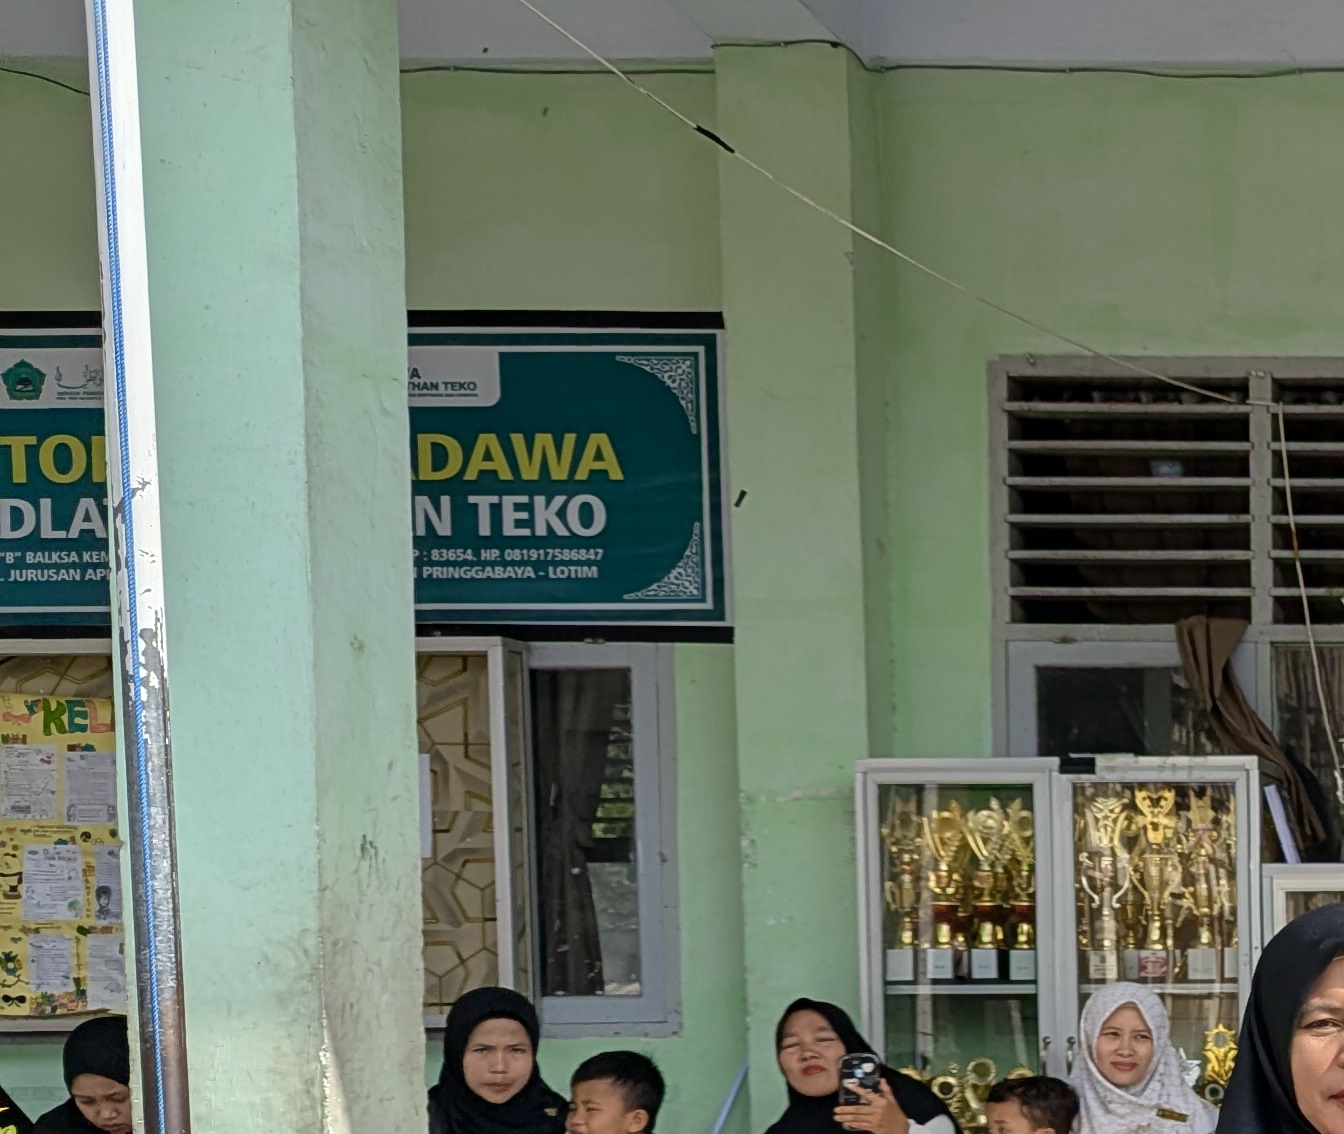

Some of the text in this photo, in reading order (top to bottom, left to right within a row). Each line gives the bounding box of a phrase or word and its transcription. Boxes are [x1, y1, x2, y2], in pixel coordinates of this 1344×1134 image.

[442, 381, 477, 391] TEKO
[468, 493, 607, 537] TEKO
[26, 551, 79, 563] BALKSA
[431, 548, 478, 561] 83654.
[481, 548, 501, 561] HP.
[504, 548, 604, 561] 081917586847
[9, 569, 81, 581] JURUSAN
[422, 566, 536, 579] PRINGGABAYA
[548, 566, 598, 579] LOTIM
